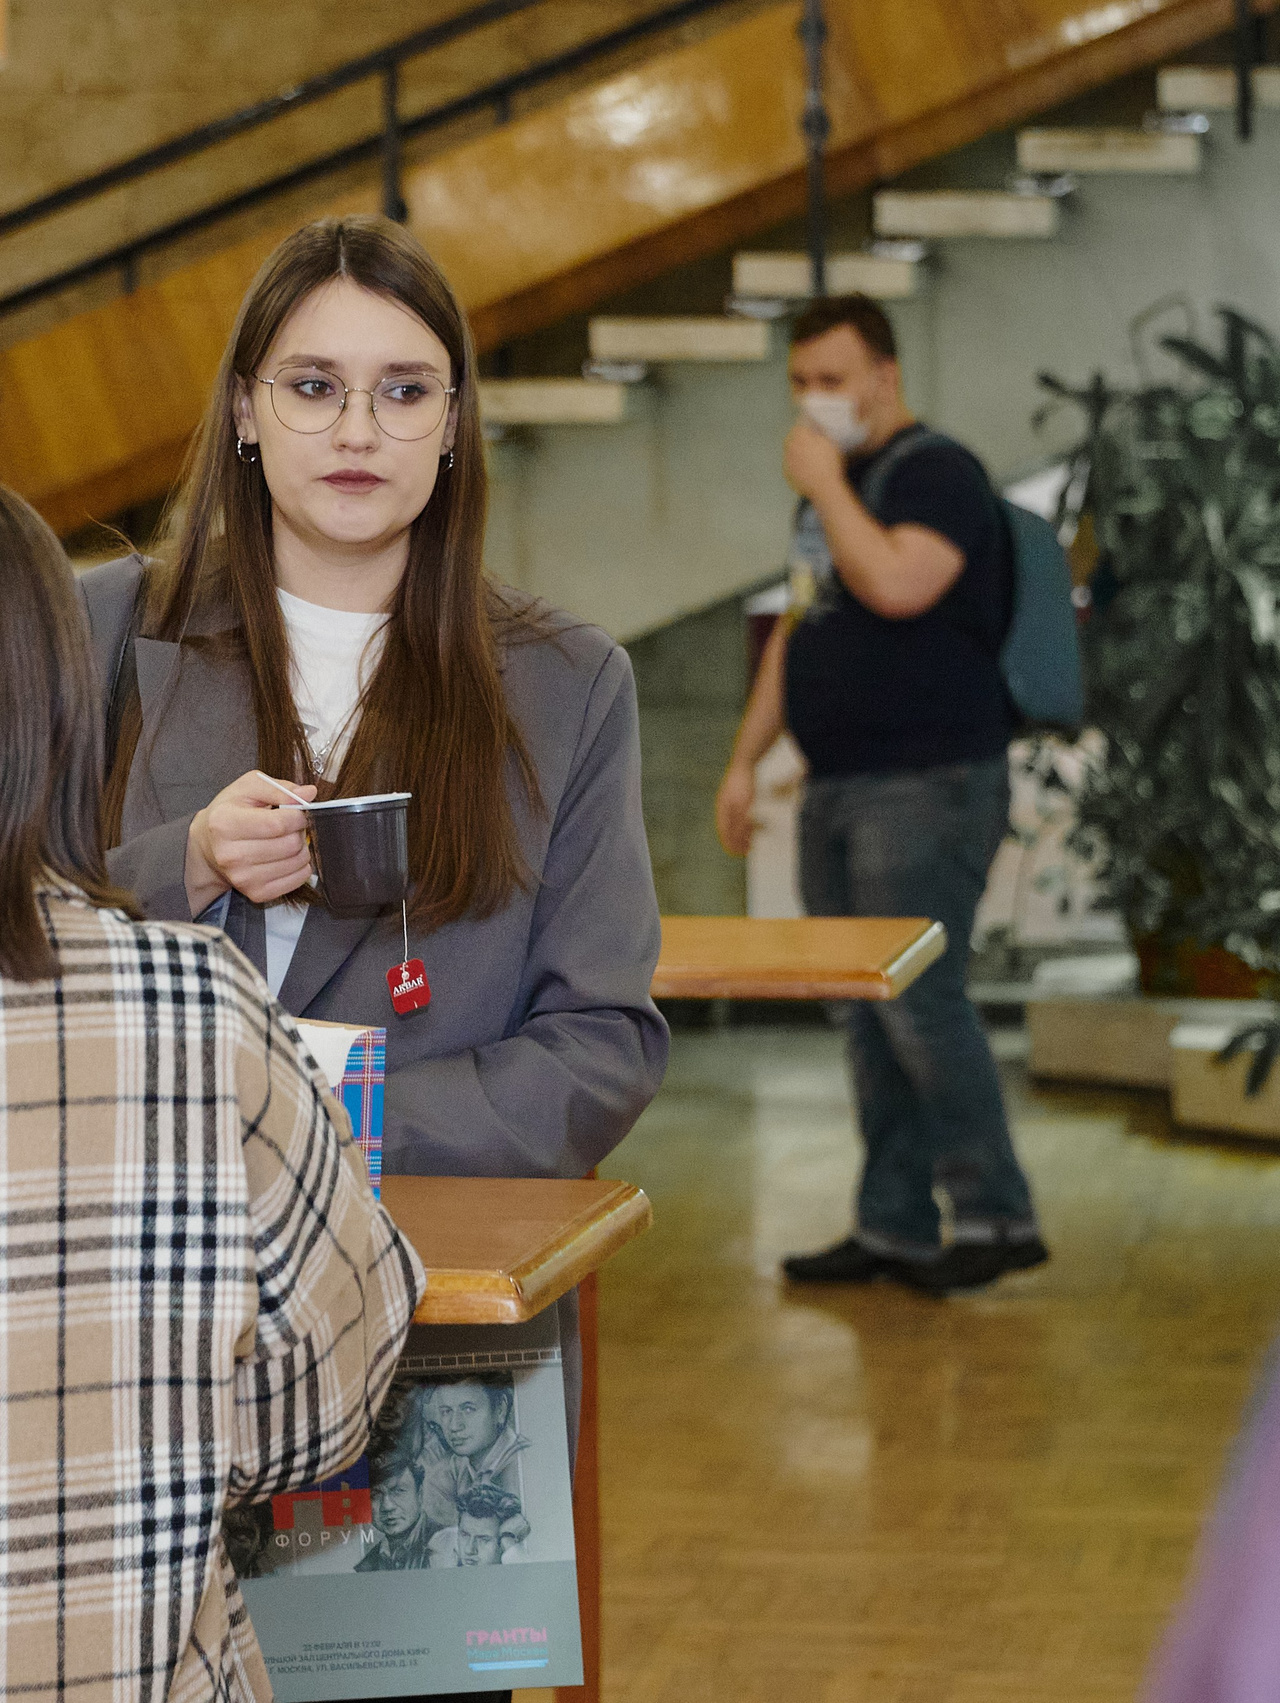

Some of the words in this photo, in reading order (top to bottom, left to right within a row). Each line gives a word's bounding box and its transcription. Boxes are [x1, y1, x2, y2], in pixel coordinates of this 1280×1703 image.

[393, 977, 424, 995] AKBAR
[275, 1528, 374, 1548] ФОРУМ
[465, 1627, 547, 1646] ГРАНТЫ
[313, 1641, 352, 1651] ФЕВРАЛЯ
[263, 1655, 297, 1664] ЛЬШОЙ
[382, 1648, 405, 1659] ДОМА
